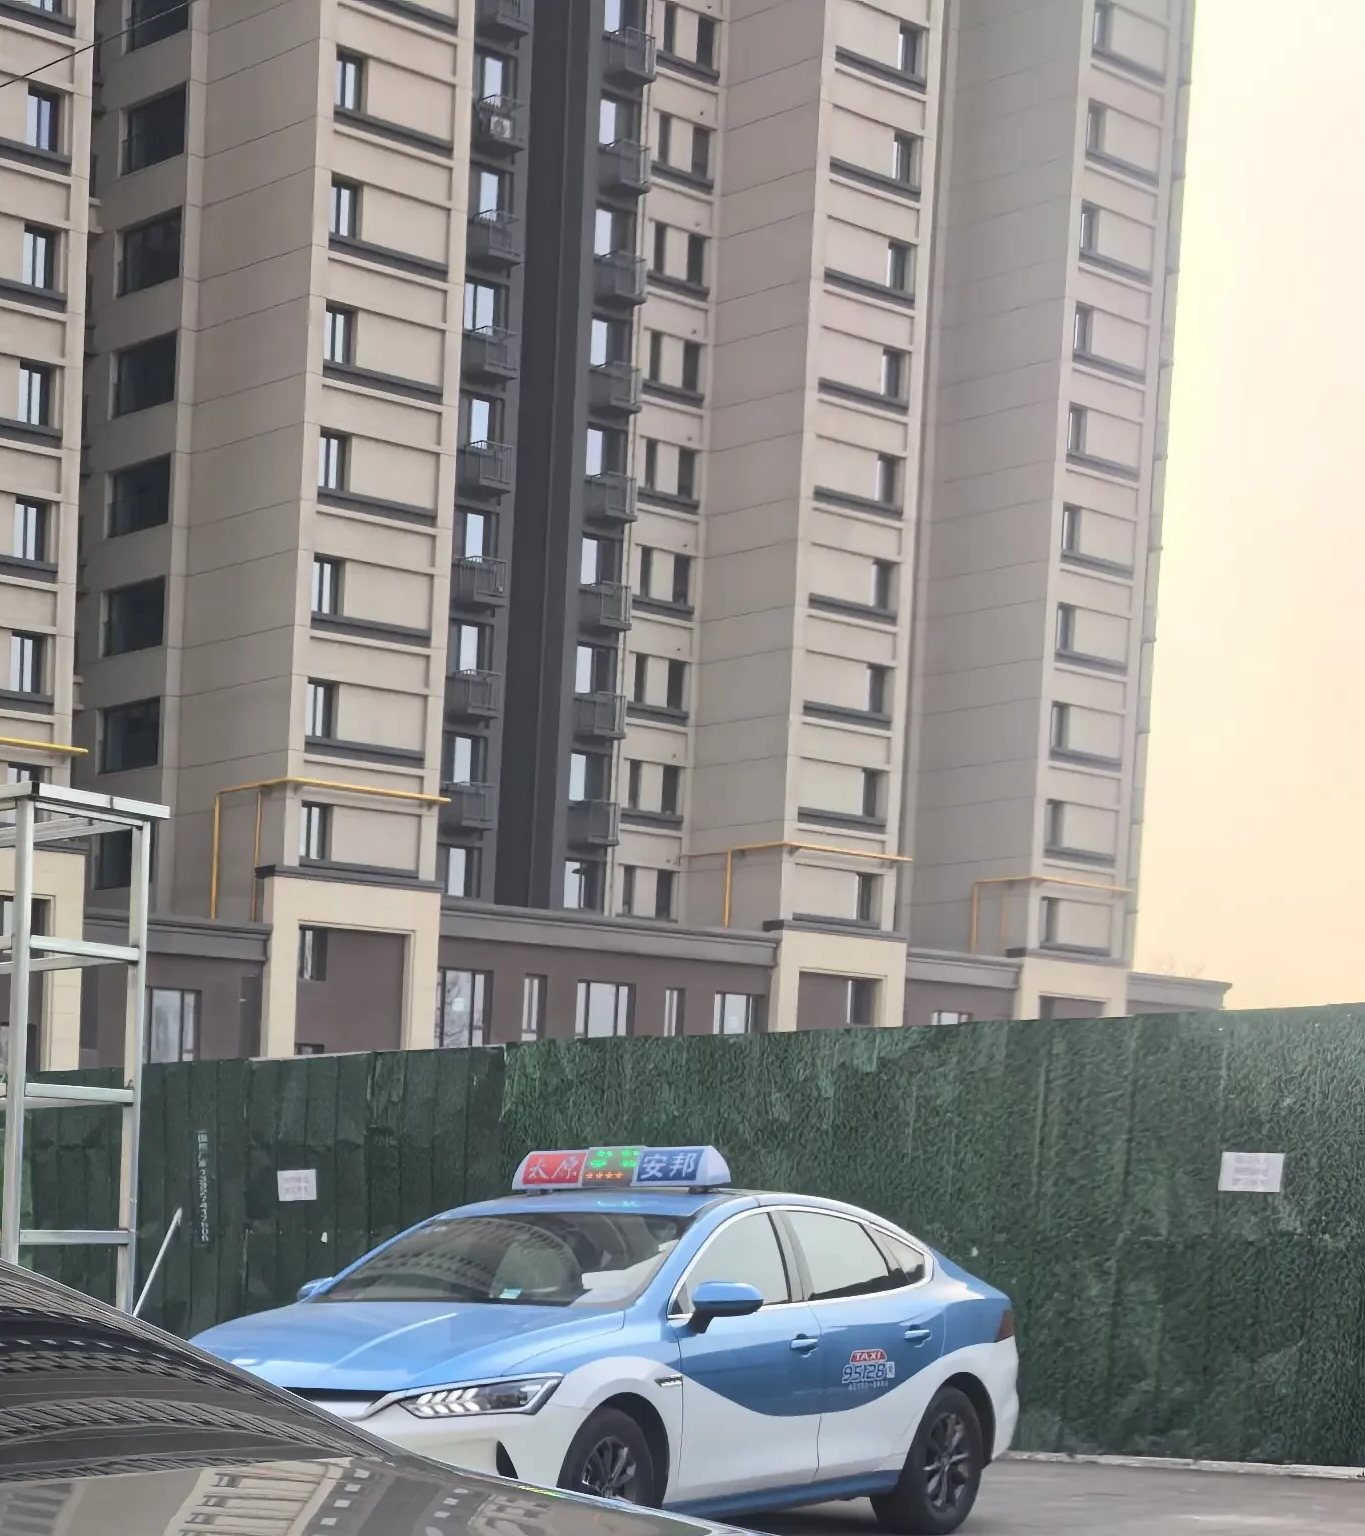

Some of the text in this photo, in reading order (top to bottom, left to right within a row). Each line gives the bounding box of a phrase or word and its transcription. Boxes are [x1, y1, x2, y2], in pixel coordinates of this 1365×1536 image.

[528, 1155, 578, 1180] 太原
[640, 1152, 698, 1179] 安邦
[856, 1352, 881, 1361] TAXI
[843, 1364, 886, 1383] 95128
